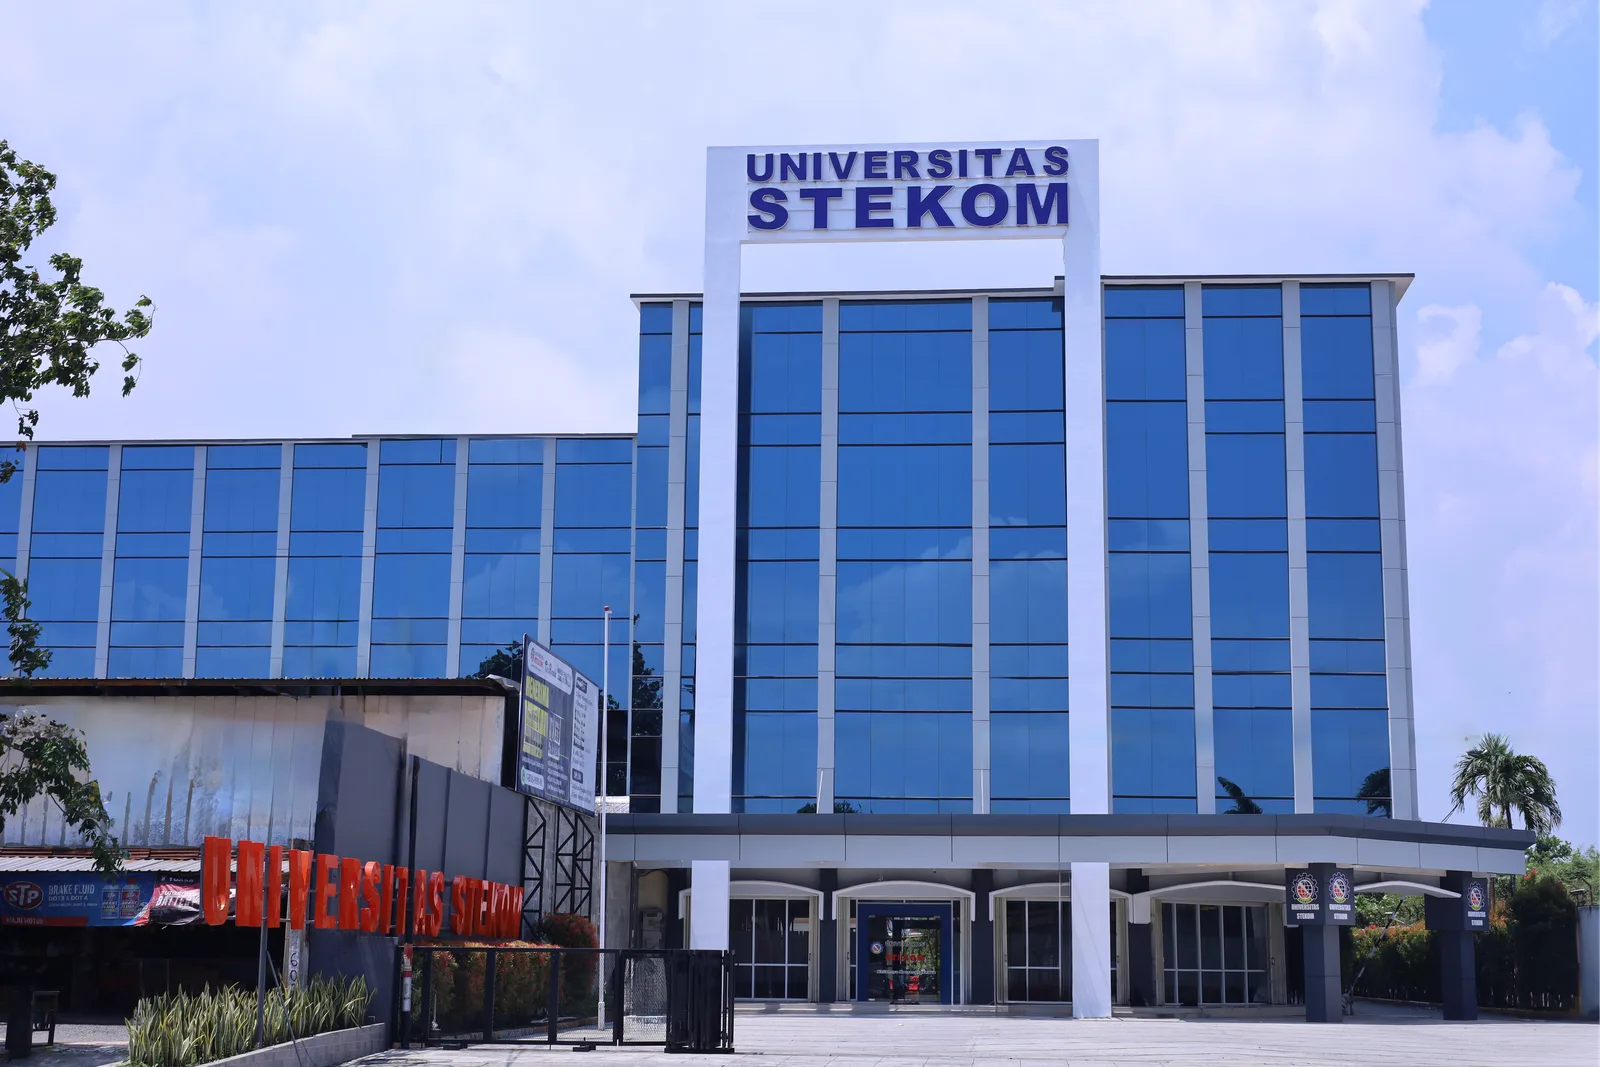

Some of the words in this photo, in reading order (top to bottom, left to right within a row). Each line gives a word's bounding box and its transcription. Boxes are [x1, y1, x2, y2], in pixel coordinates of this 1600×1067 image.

[747, 146, 1069, 182] UNIVERSITAS
[747, 182, 1069, 230] STEKOM
[8, 884, 40, 906] STP
[48, 884, 73, 895] BRAKE
[74, 884, 95, 895] FLUID
[203, 836, 444, 937] UNIVERSITAS
[451, 875, 524, 939] STEKOM
